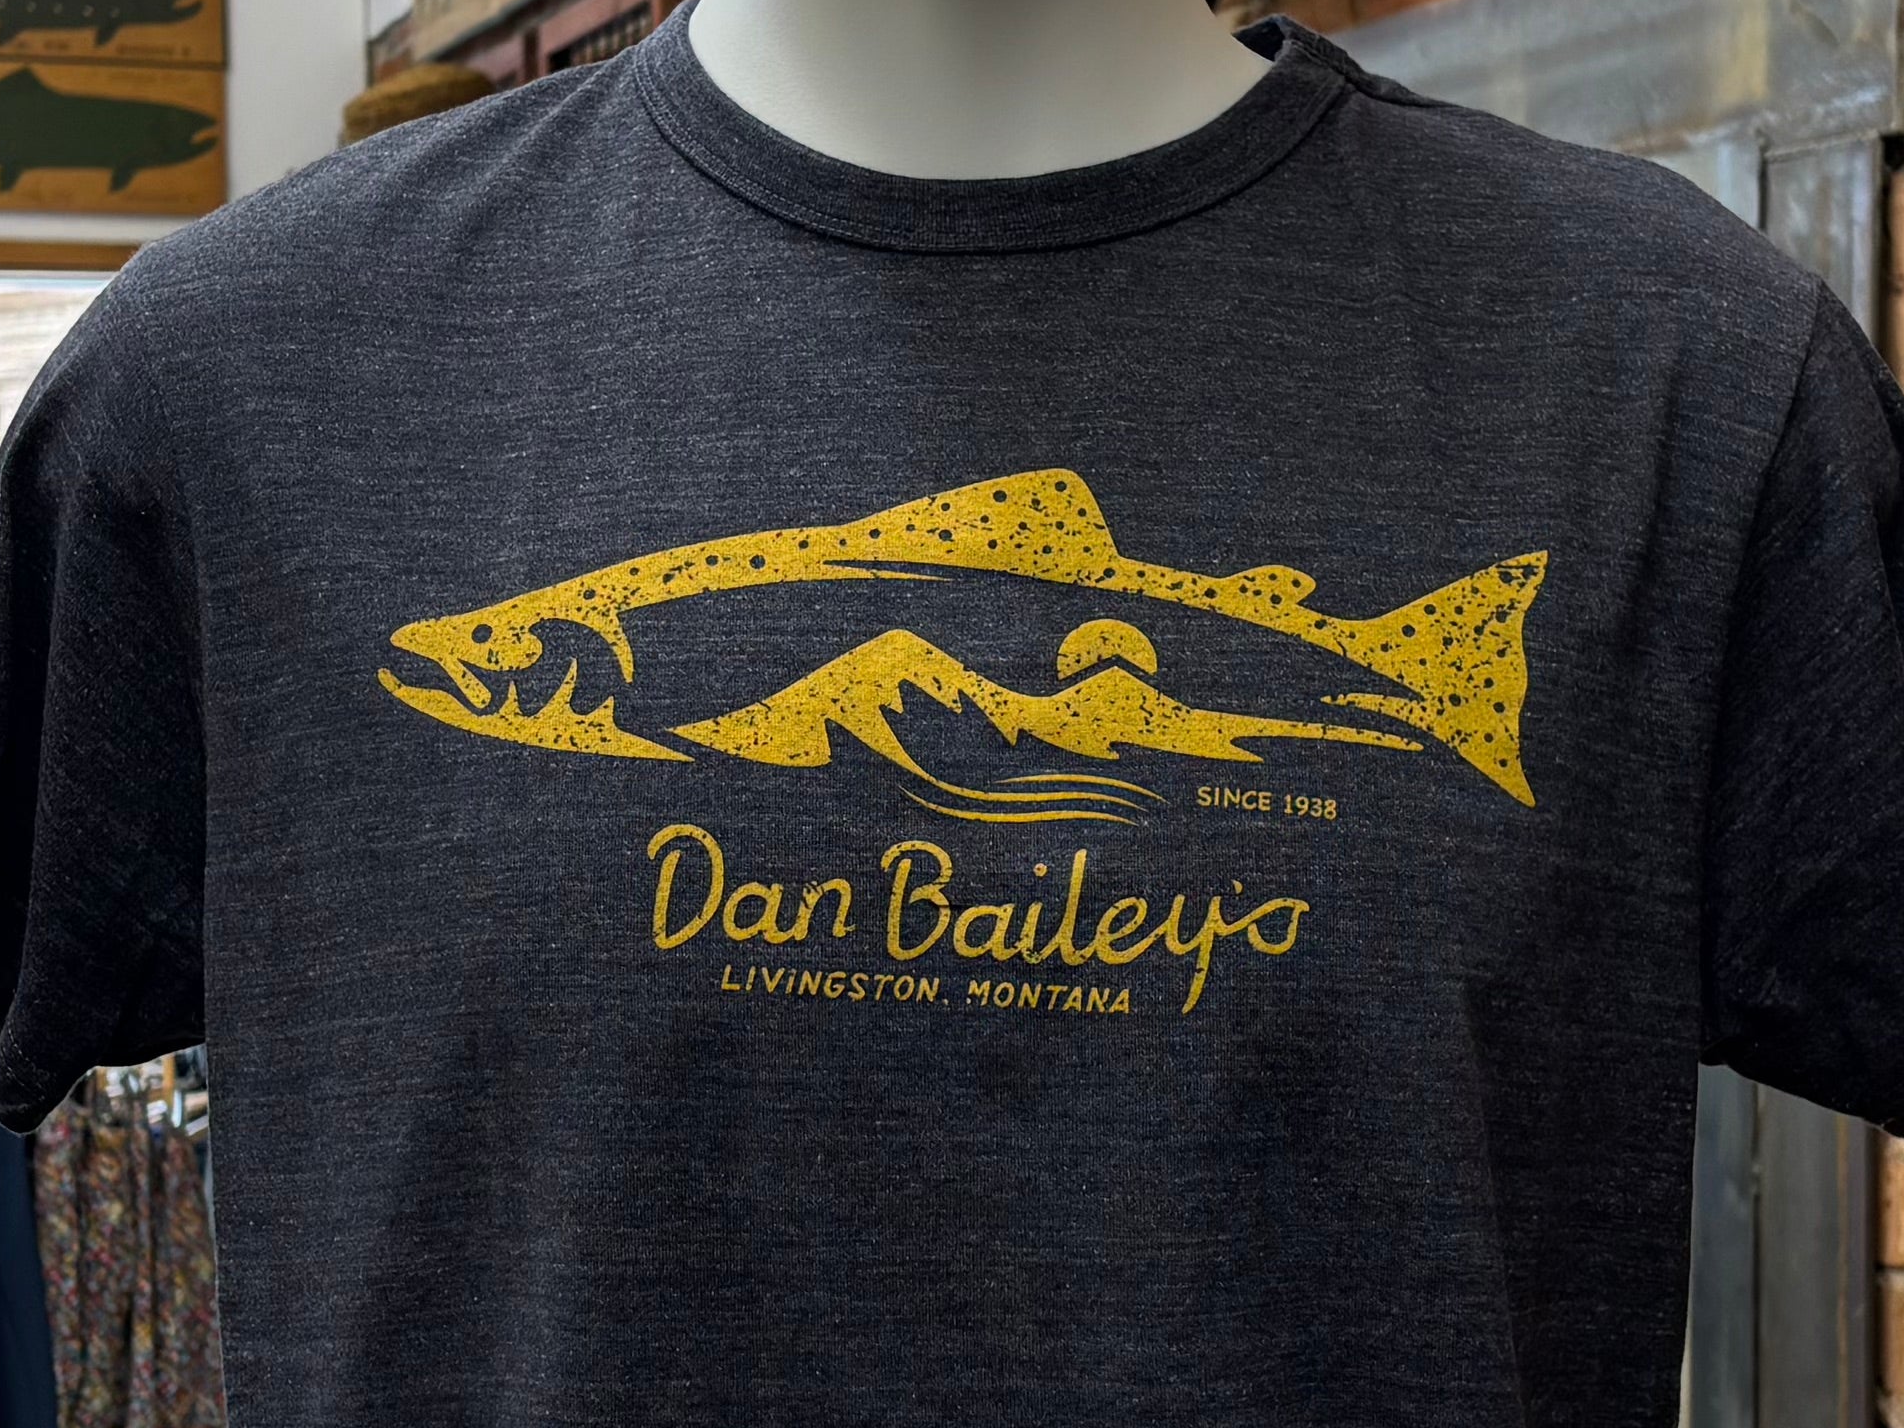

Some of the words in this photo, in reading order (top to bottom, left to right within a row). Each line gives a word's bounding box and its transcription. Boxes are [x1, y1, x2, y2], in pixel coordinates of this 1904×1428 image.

[1198, 786, 1272, 812] SINCE
[1283, 795, 1338, 821] 1938
[647, 824, 856, 951] Dan
[880, 840, 1311, 1015] Bailey's
[966, 979, 1131, 1015] MONTANA
